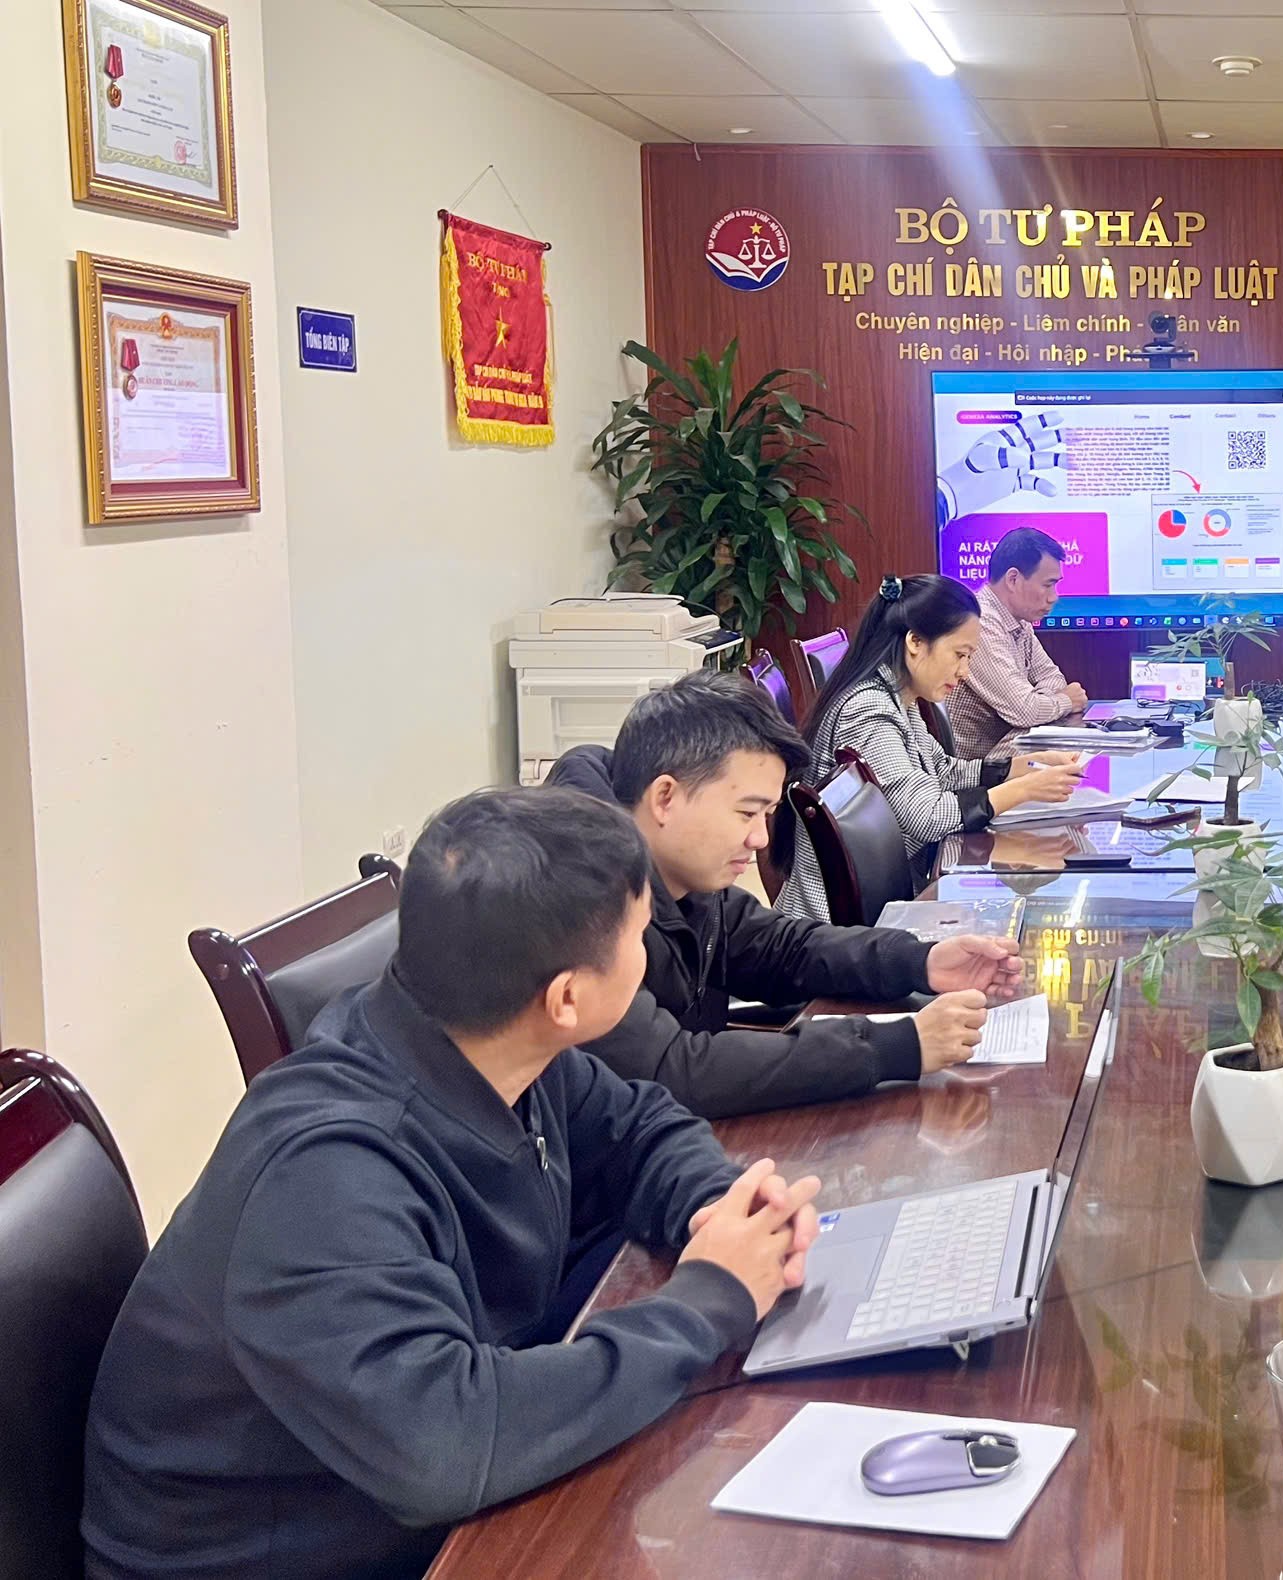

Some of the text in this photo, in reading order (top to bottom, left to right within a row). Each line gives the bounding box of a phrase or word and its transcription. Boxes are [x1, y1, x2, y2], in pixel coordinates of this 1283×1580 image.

[895, 196, 1206, 255] BỘ TƯ PHÁP
[822, 254, 1278, 306] TẠP CHÍ DÂN CHỦ VÀ PHÁP LUẬT
[855, 312, 930, 333] Chuyên
[937, 313, 1004, 335] nghiệp
[1024, 313, 1069, 332] Liêm
[1077, 314, 1130, 332] chính
[1207, 315, 1240, 332] văn
[899, 343, 943, 364] Hiện
[950, 344, 979, 364] đại
[999, 344, 1029, 364] Hội
[1039, 344, 1087, 365] nhập
[959, 543, 970, 552] AI
